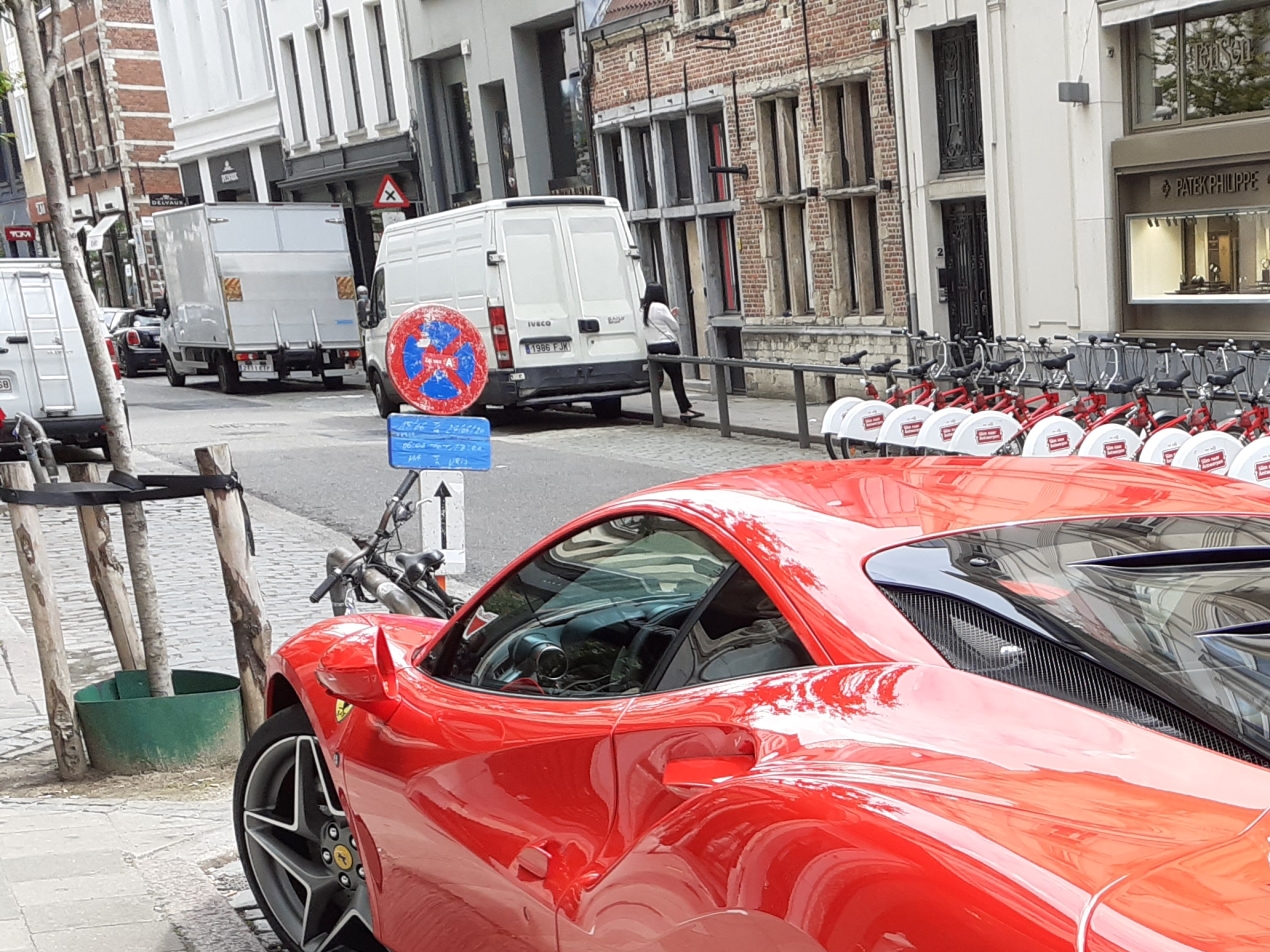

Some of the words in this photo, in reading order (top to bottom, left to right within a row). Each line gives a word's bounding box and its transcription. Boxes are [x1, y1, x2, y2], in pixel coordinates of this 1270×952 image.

[1176, 174, 1210, 198] PATEK
[1210, 170, 1260, 195] PHILIPPE
[937, 248, 943, 256] 2
